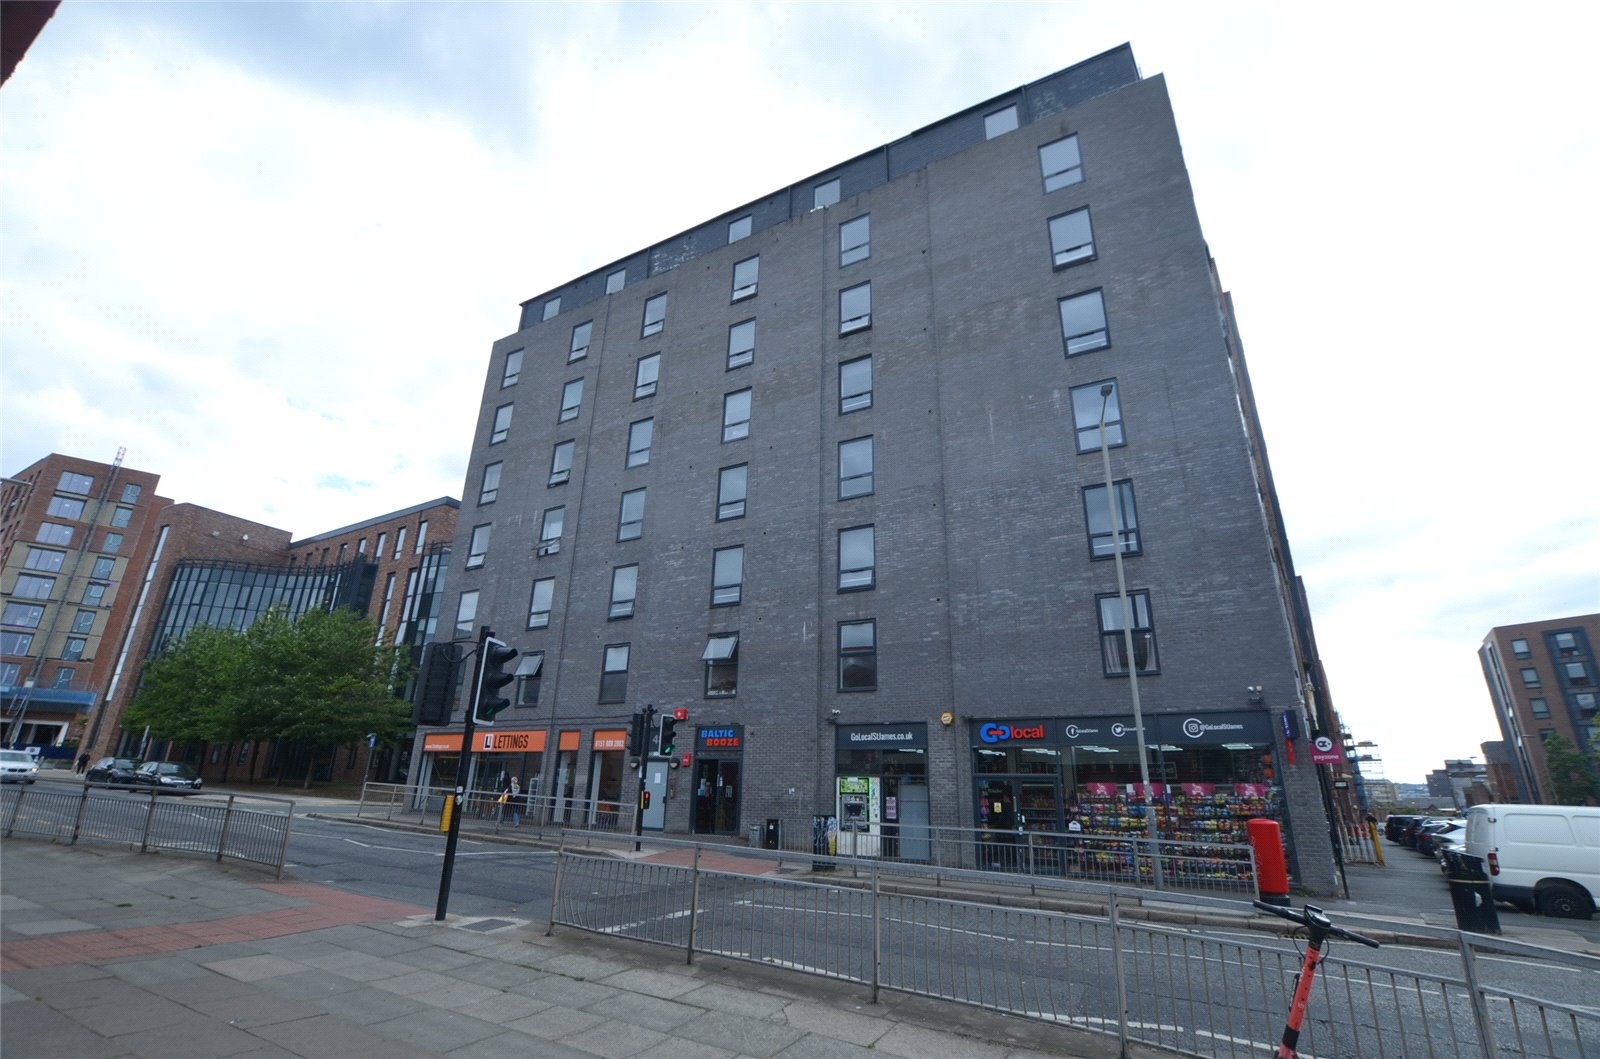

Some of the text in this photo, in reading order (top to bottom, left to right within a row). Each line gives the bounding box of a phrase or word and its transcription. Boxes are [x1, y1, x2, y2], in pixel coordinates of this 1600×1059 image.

[701, 729, 735, 738] BALTIC
[850, 731, 913, 741] GoLocalStJames.co.uk
[1010, 724, 1044, 739] local
[493, 734, 529, 749] LETTINGS
[706, 738, 740, 747] BOOZE
